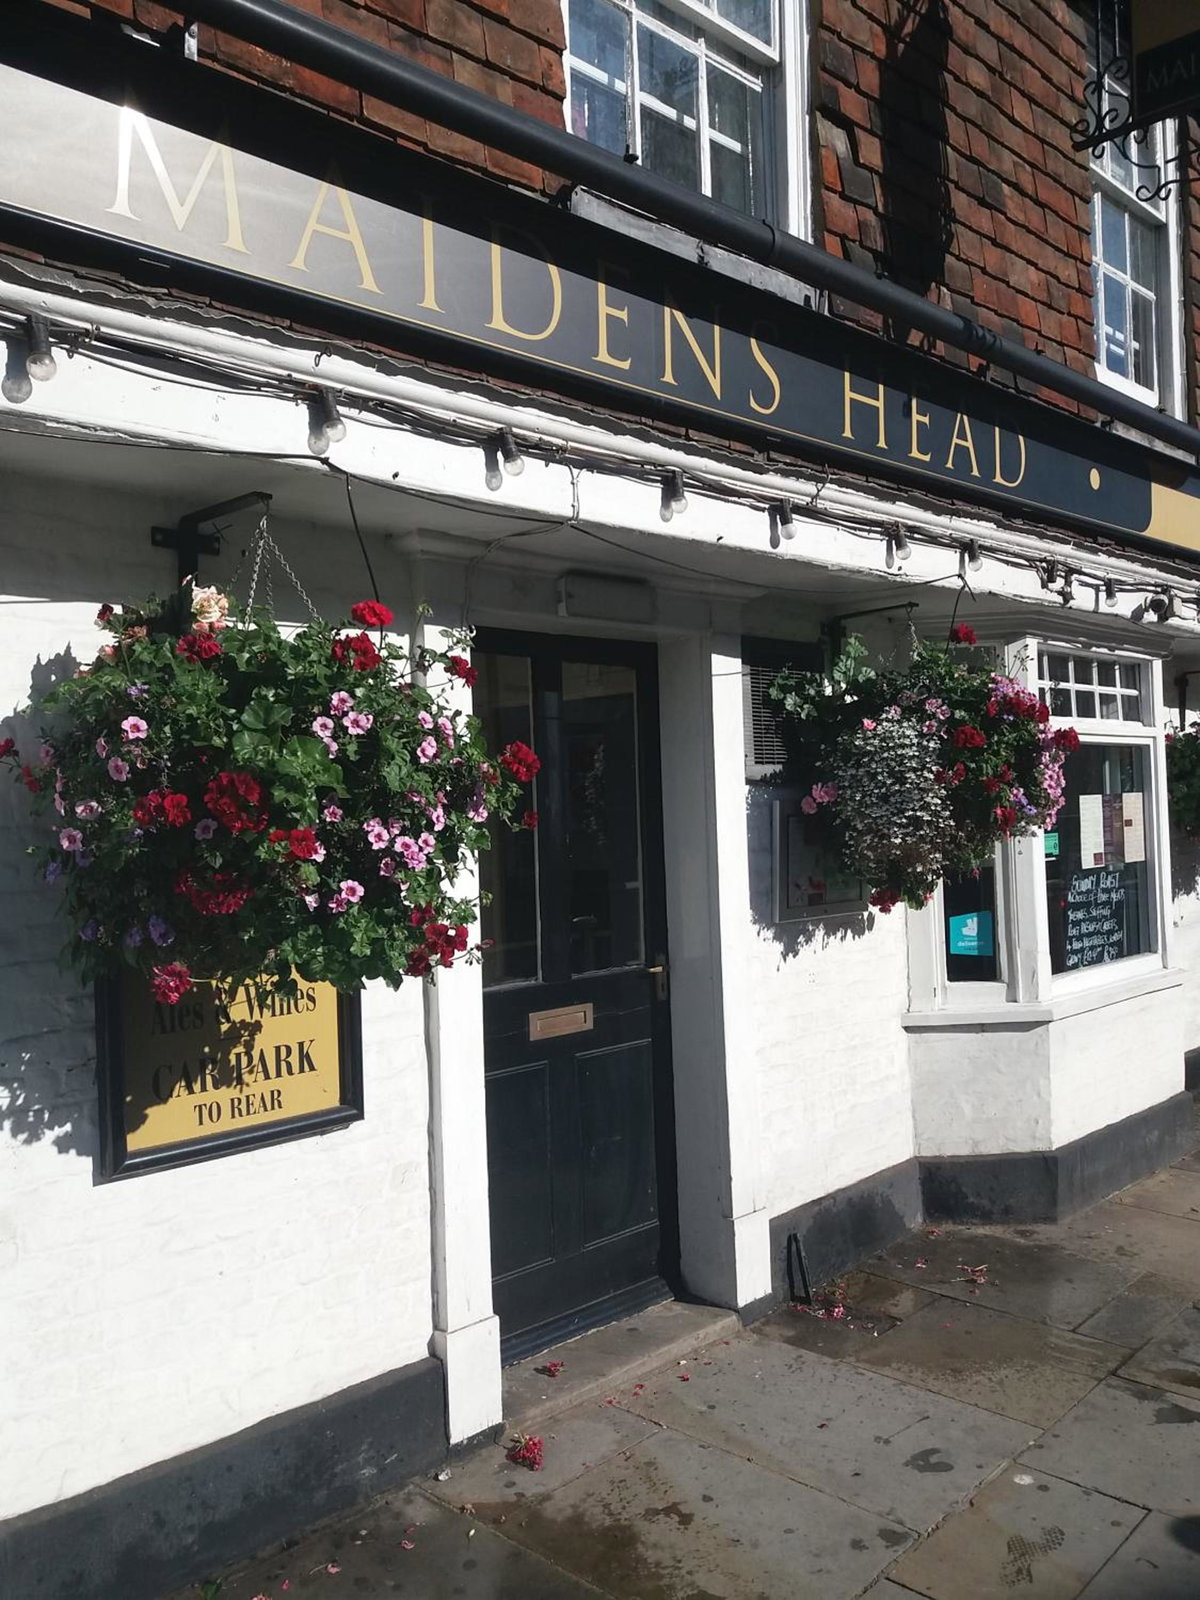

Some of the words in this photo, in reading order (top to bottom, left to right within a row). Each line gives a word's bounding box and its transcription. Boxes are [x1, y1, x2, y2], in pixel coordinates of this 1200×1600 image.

[105, 90, 781, 414] MAIDENS
[842, 357, 1027, 489] HEAD
[151, 1002, 204, 1036] Ales
[153, 1059, 221, 1101] CAR
[234, 1039, 317, 1088] PARK
[193, 1101, 222, 1126] TO
[229, 1088, 283, 1120] REAR
